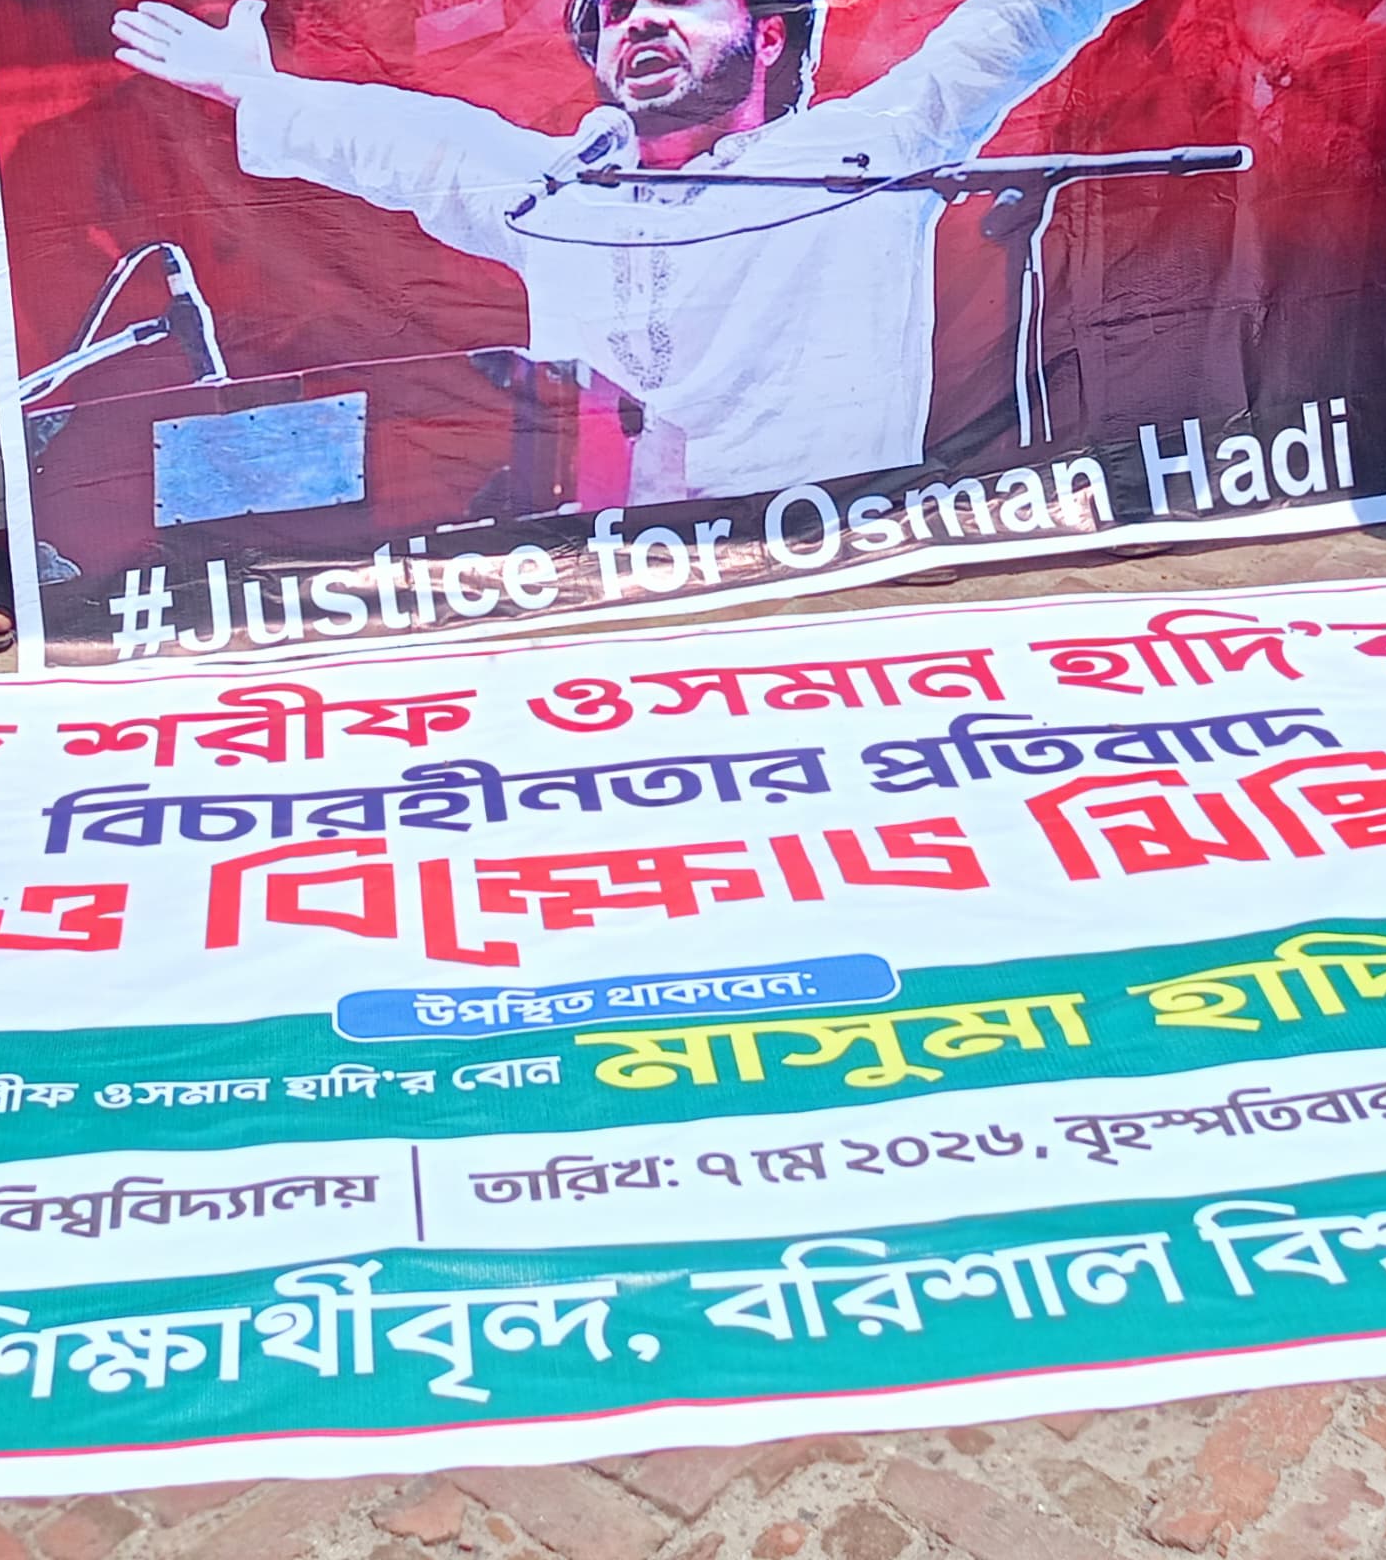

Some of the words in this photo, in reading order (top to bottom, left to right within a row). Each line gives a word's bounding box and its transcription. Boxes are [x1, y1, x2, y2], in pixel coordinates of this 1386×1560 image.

[108, 536, 559, 662] #Justice
[587, 507, 733, 603] for
[763, 451, 1114, 571] Osman
[1138, 396, 1354, 517] Hadi
[58, 684, 477, 768] শরীফ
[527, 648, 1006, 732] ওসমান
[42, 747, 831, 853] বিচারহীনতার
[861, 708, 1343, 794] প্রতিবাদে
[205, 816, 990, 967] বিক্ষোভ
[93, 1074, 271, 1111] ওসমান
[451, 1055, 562, 1093] বোন
[574, 992, 1092, 1089] মাসুমা
[413, 990, 594, 1028] উপস্থিত
[607, 971, 816, 1008] থাকবেন:
[469, 1156, 679, 1206] তারিখ:
[696, 1149, 743, 1187] ৭
[750, 1141, 828, 1184] মে
[845, 1122, 1048, 1172] ২০২৬,
[690, 1230, 1186, 1341] বরিশাল
